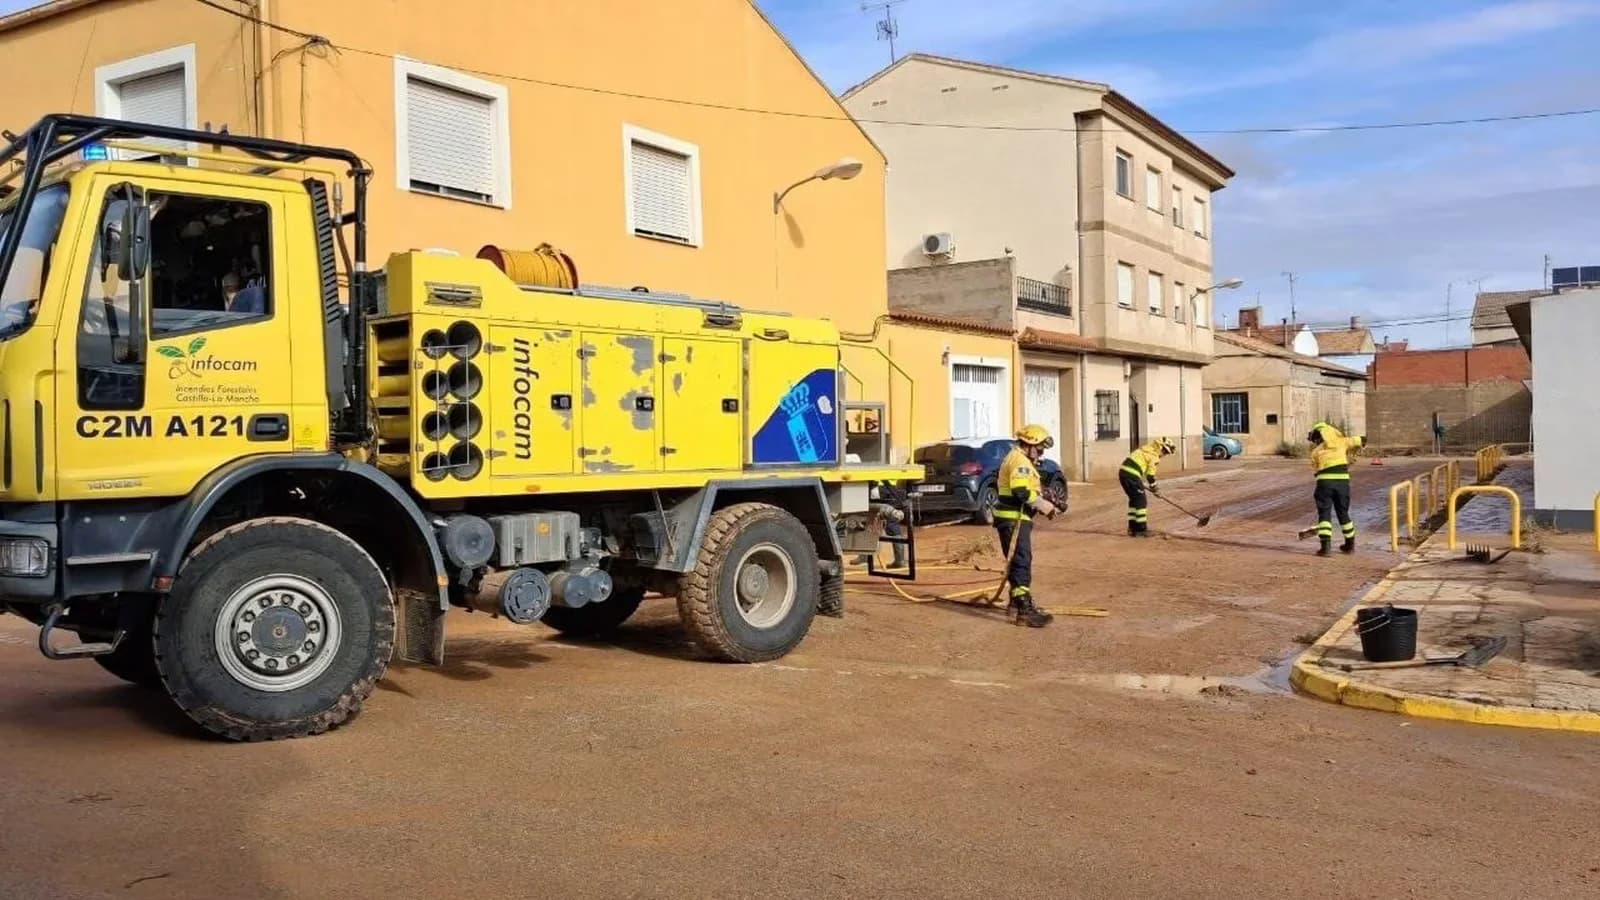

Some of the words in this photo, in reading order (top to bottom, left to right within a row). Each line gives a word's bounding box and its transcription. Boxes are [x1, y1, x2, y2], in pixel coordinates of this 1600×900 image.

[190, 354, 257, 371] infocam
[513, 338, 539, 459] infocam
[76, 415, 152, 438] C2M
[164, 415, 244, 437] A121
